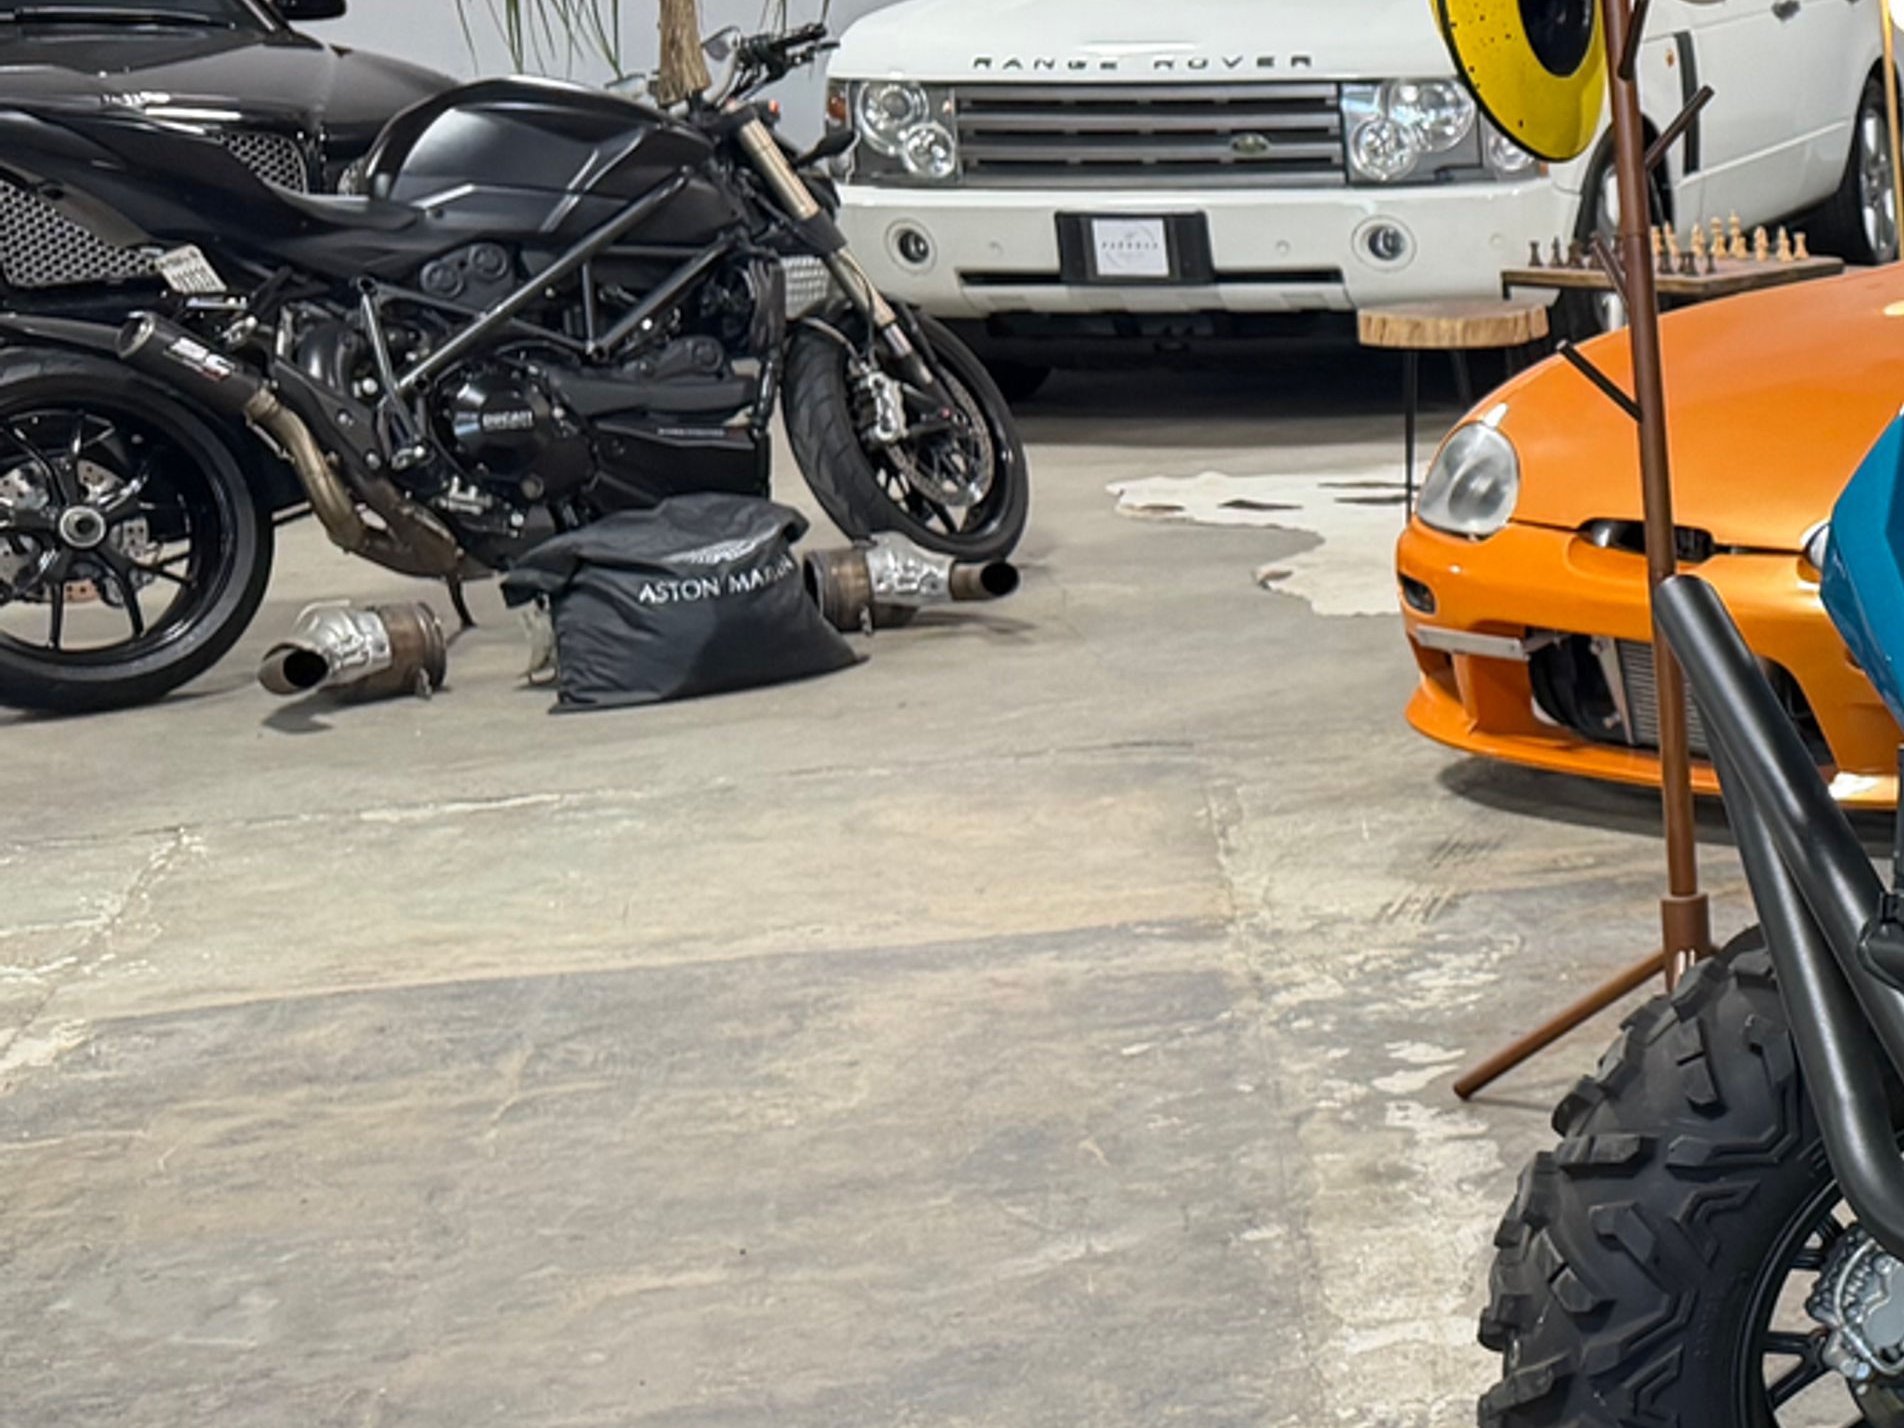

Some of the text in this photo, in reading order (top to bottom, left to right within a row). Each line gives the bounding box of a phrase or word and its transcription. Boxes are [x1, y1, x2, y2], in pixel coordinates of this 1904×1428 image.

[973, 55, 1312, 71] RANGE ROVER
[639, 577, 720, 604] ASTON
